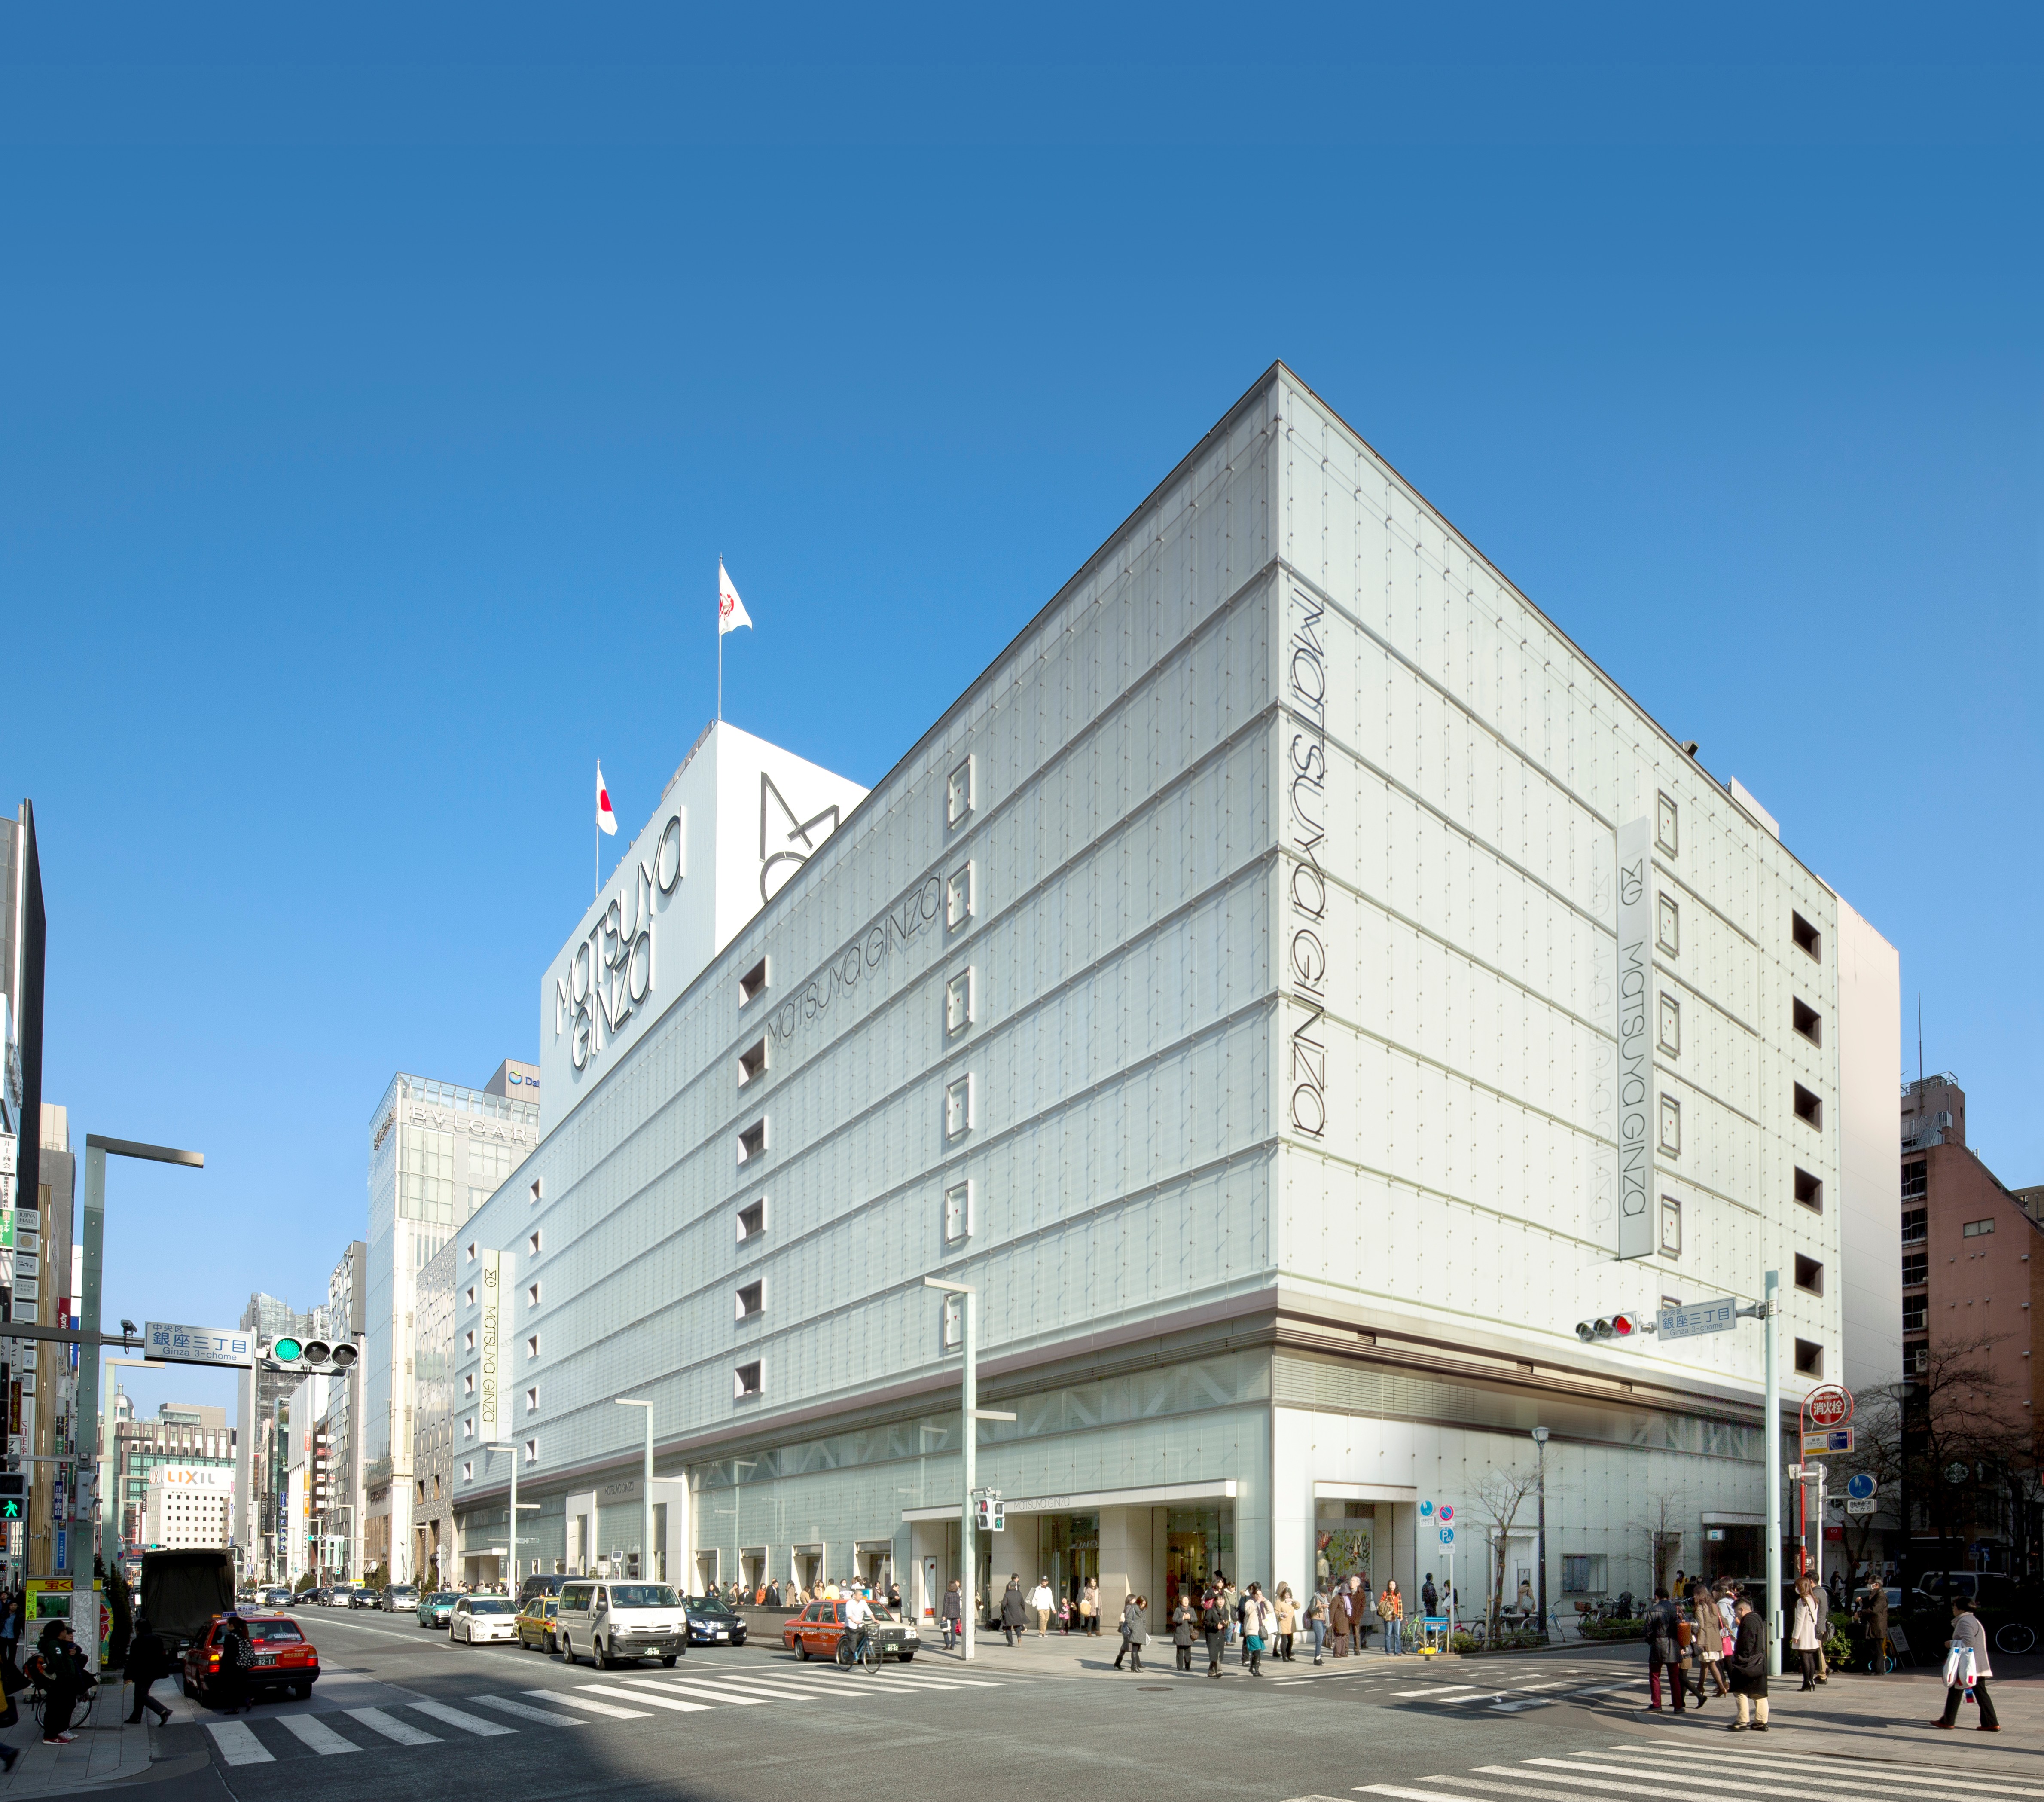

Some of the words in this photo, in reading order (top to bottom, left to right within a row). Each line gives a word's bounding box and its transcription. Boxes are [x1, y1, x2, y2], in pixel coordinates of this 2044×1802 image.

[525, 1076, 540, 1088] Dai
[411, 1106, 539, 1145] BVLGARI
[1662, 1308, 1682, 1317] 中央区
[1663, 1307, 1729, 1330] 銀座三丁目
[153, 1324, 183, 1333] 中央区
[1670, 1328, 1689, 1336] Ginza
[1692, 1322, 1723, 1332] 3-chome
[153, 1332, 246, 1353] 銀座三丁目
[163, 1347, 190, 1356] Ginza
[195, 1350, 237, 1361] 3-chome
[1813, 1400, 1843, 1416] 消火栓
[168, 1470, 215, 1485] LIXIL
[55, 1485, 63, 1516] 洋服の青山
[1442, 1530, 1448, 1542] P
